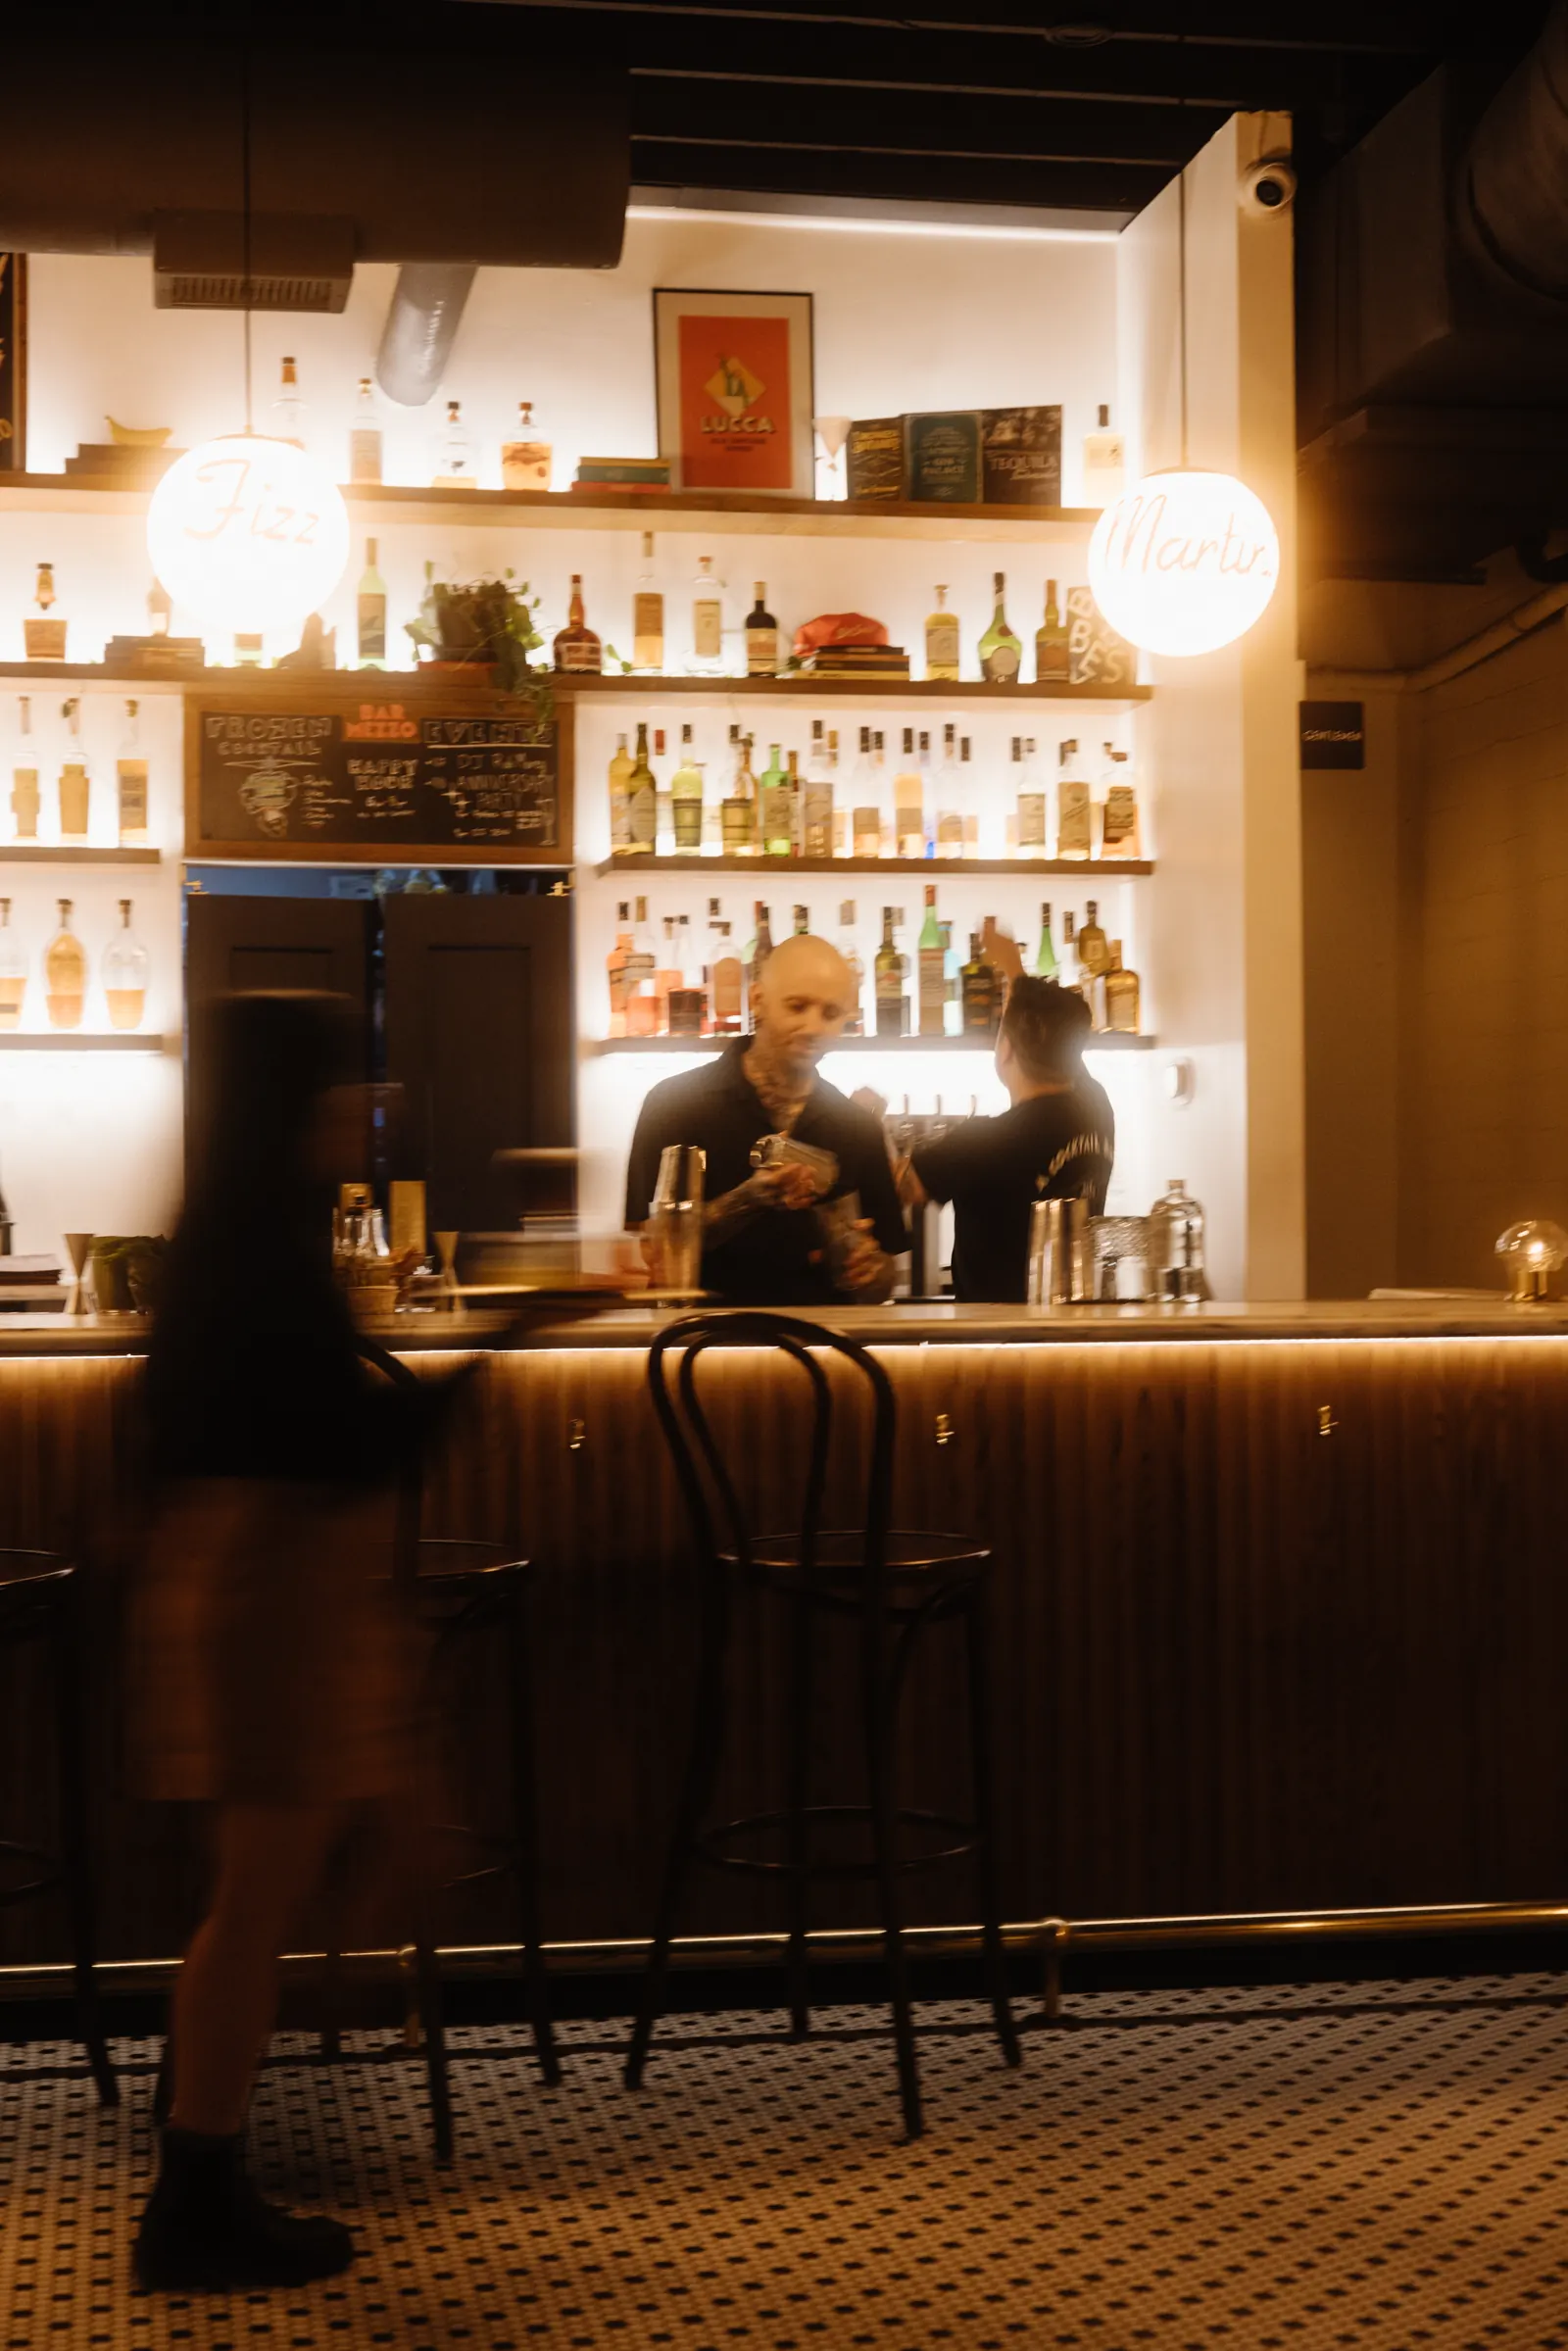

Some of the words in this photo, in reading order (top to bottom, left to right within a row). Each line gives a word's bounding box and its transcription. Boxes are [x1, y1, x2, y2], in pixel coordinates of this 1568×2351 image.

[700, 416, 778, 434] LUCCA
[183, 459, 319, 545] Fizz
[359, 704, 405, 719] BAR
[204, 716, 333, 740] FROZEN
[346, 721, 418, 738] MEZZO
[422, 720, 555, 744] EVENTS
[347, 759, 419, 777] HAPPY
[355, 775, 415, 791] HOUR
